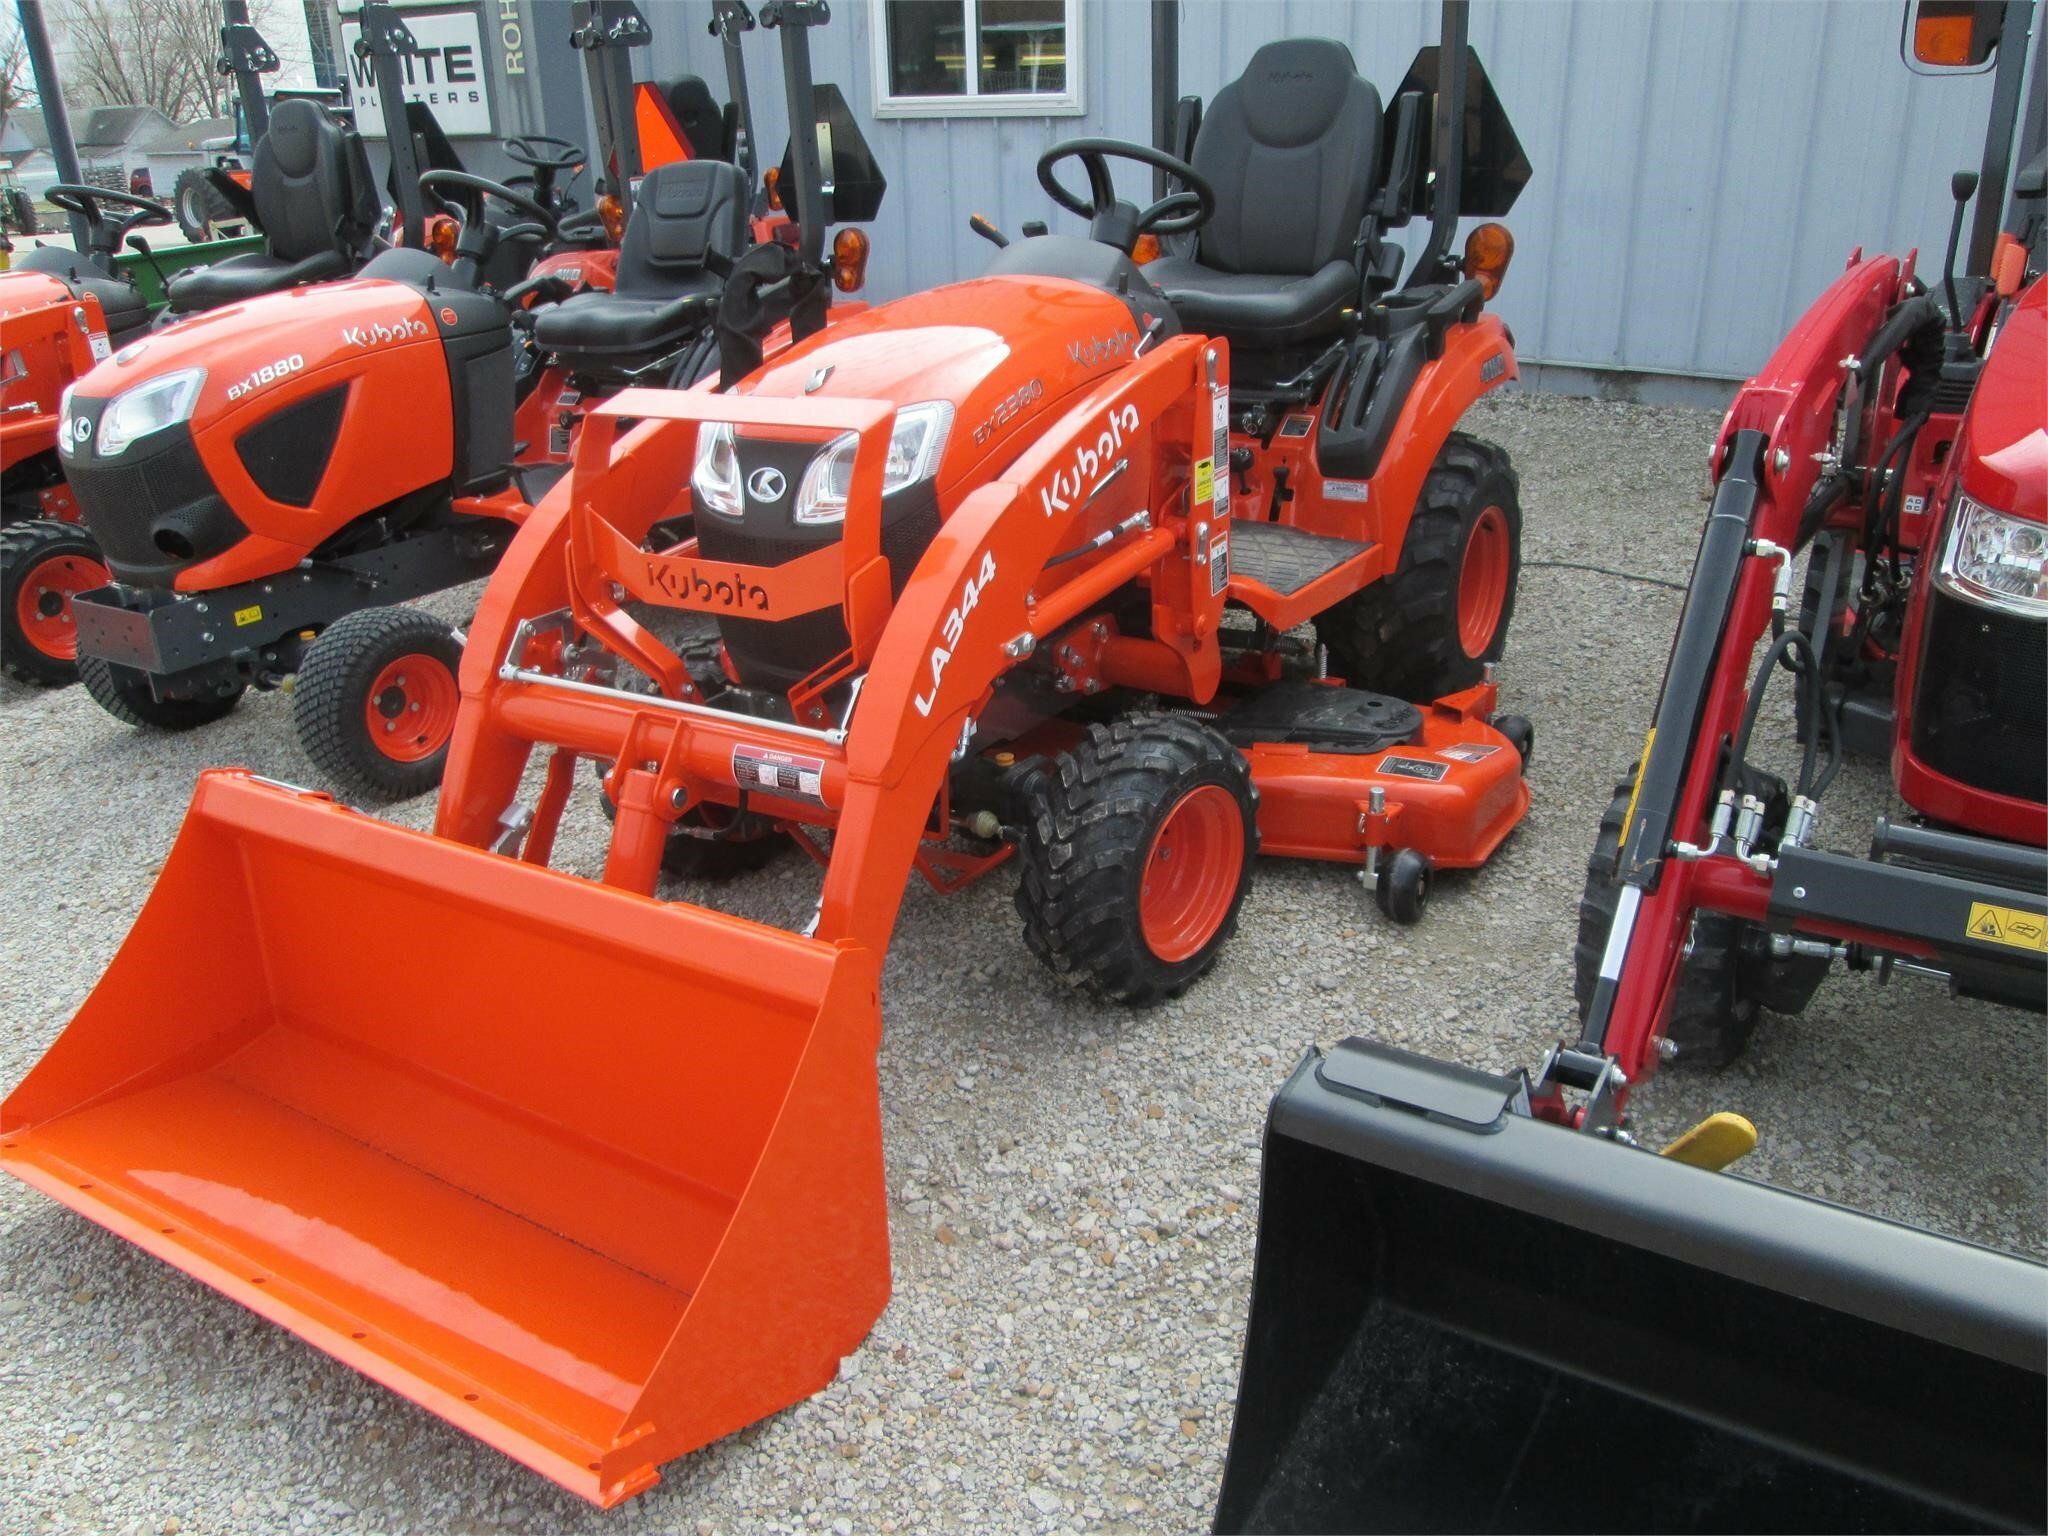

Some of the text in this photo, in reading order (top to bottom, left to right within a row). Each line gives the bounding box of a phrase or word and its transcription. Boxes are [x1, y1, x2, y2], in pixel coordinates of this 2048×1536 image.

[350, 45, 476, 88] WITE
[360, 91, 480, 107] PLTERS
[342, 317, 429, 348] Kubota
[1066, 327, 1138, 369] Kubota
[227, 354, 305, 401] BX1880
[1040, 403, 1140, 518] Kubota
[646, 562, 769, 611] Kubota
[914, 550, 997, 718] LA344
